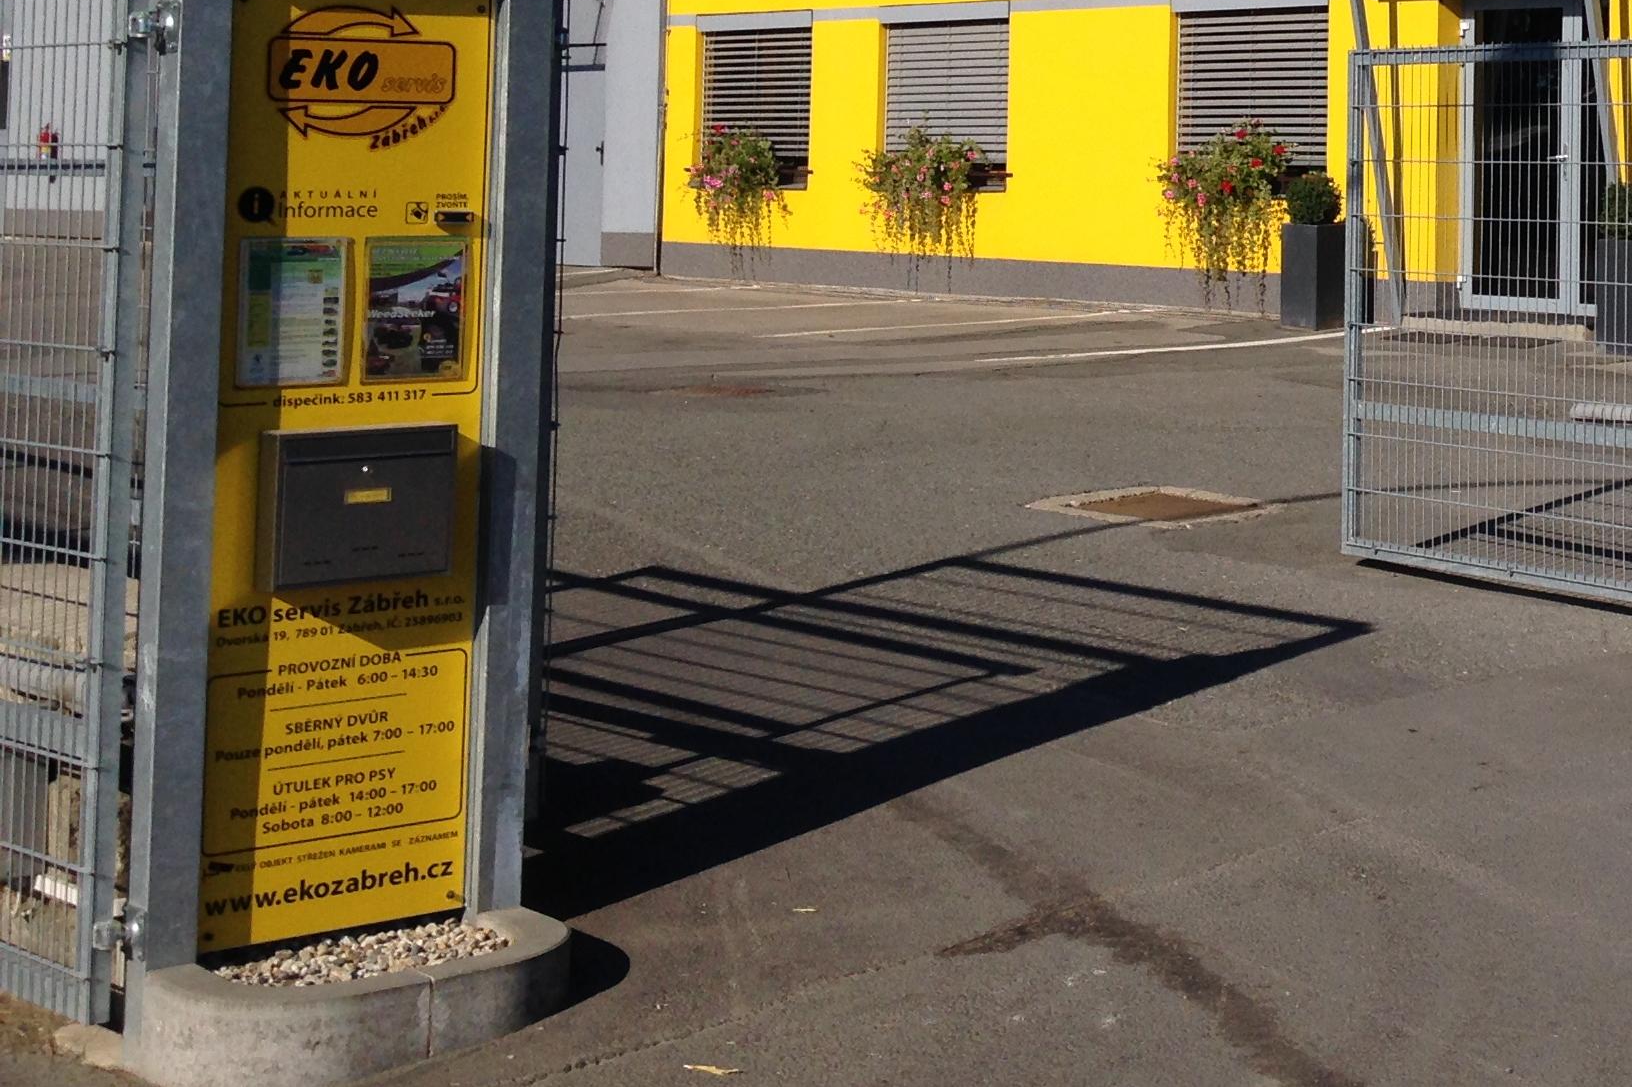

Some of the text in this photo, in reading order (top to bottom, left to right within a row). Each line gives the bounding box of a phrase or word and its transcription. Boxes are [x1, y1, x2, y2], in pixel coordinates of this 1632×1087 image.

[278, 49, 447, 94] EKO servis
[369, 115, 427, 151] Zábřeh
[278, 201, 378, 218] informace
[280, 189, 378, 200] AKTUÁLNÍ
[273, 389, 427, 408] dispečink: 583 411 317
[217, 589, 465, 628] EKO servis Zábřeh s.r.o.
[273, 630, 290, 641] 19,
[295, 627, 318, 639] 789
[320, 626, 333, 636] 01
[278, 651, 402, 676] PROVOZNÍ DOBA
[237, 680, 295, 700] Pondělí
[306, 675, 347, 691] Pátek
[357, 671, 388, 685] 6:00
[402, 665, 438, 680] 14:30
[285, 709, 389, 735] SBĚRNÝ DVŮR
[215, 748, 261, 762] Pouze
[264, 736, 324, 758] pondělí,
[327, 731, 368, 750] pátek
[373, 727, 402, 742] 7:00
[419, 720, 455, 735] 17:00
[273, 767, 396, 796] ÚTULEK PRO PSY
[230, 800, 287, 820] Pondělí
[299, 793, 340, 813] pátek
[350, 787, 387, 802] 14:00
[401, 780, 437, 795] 17:00
[262, 817, 315, 834] Sobota
[321, 810, 352, 826] 8:00
[368, 803, 404, 818] 12:00
[204, 860, 454, 917] www.ekozabreh.cz
